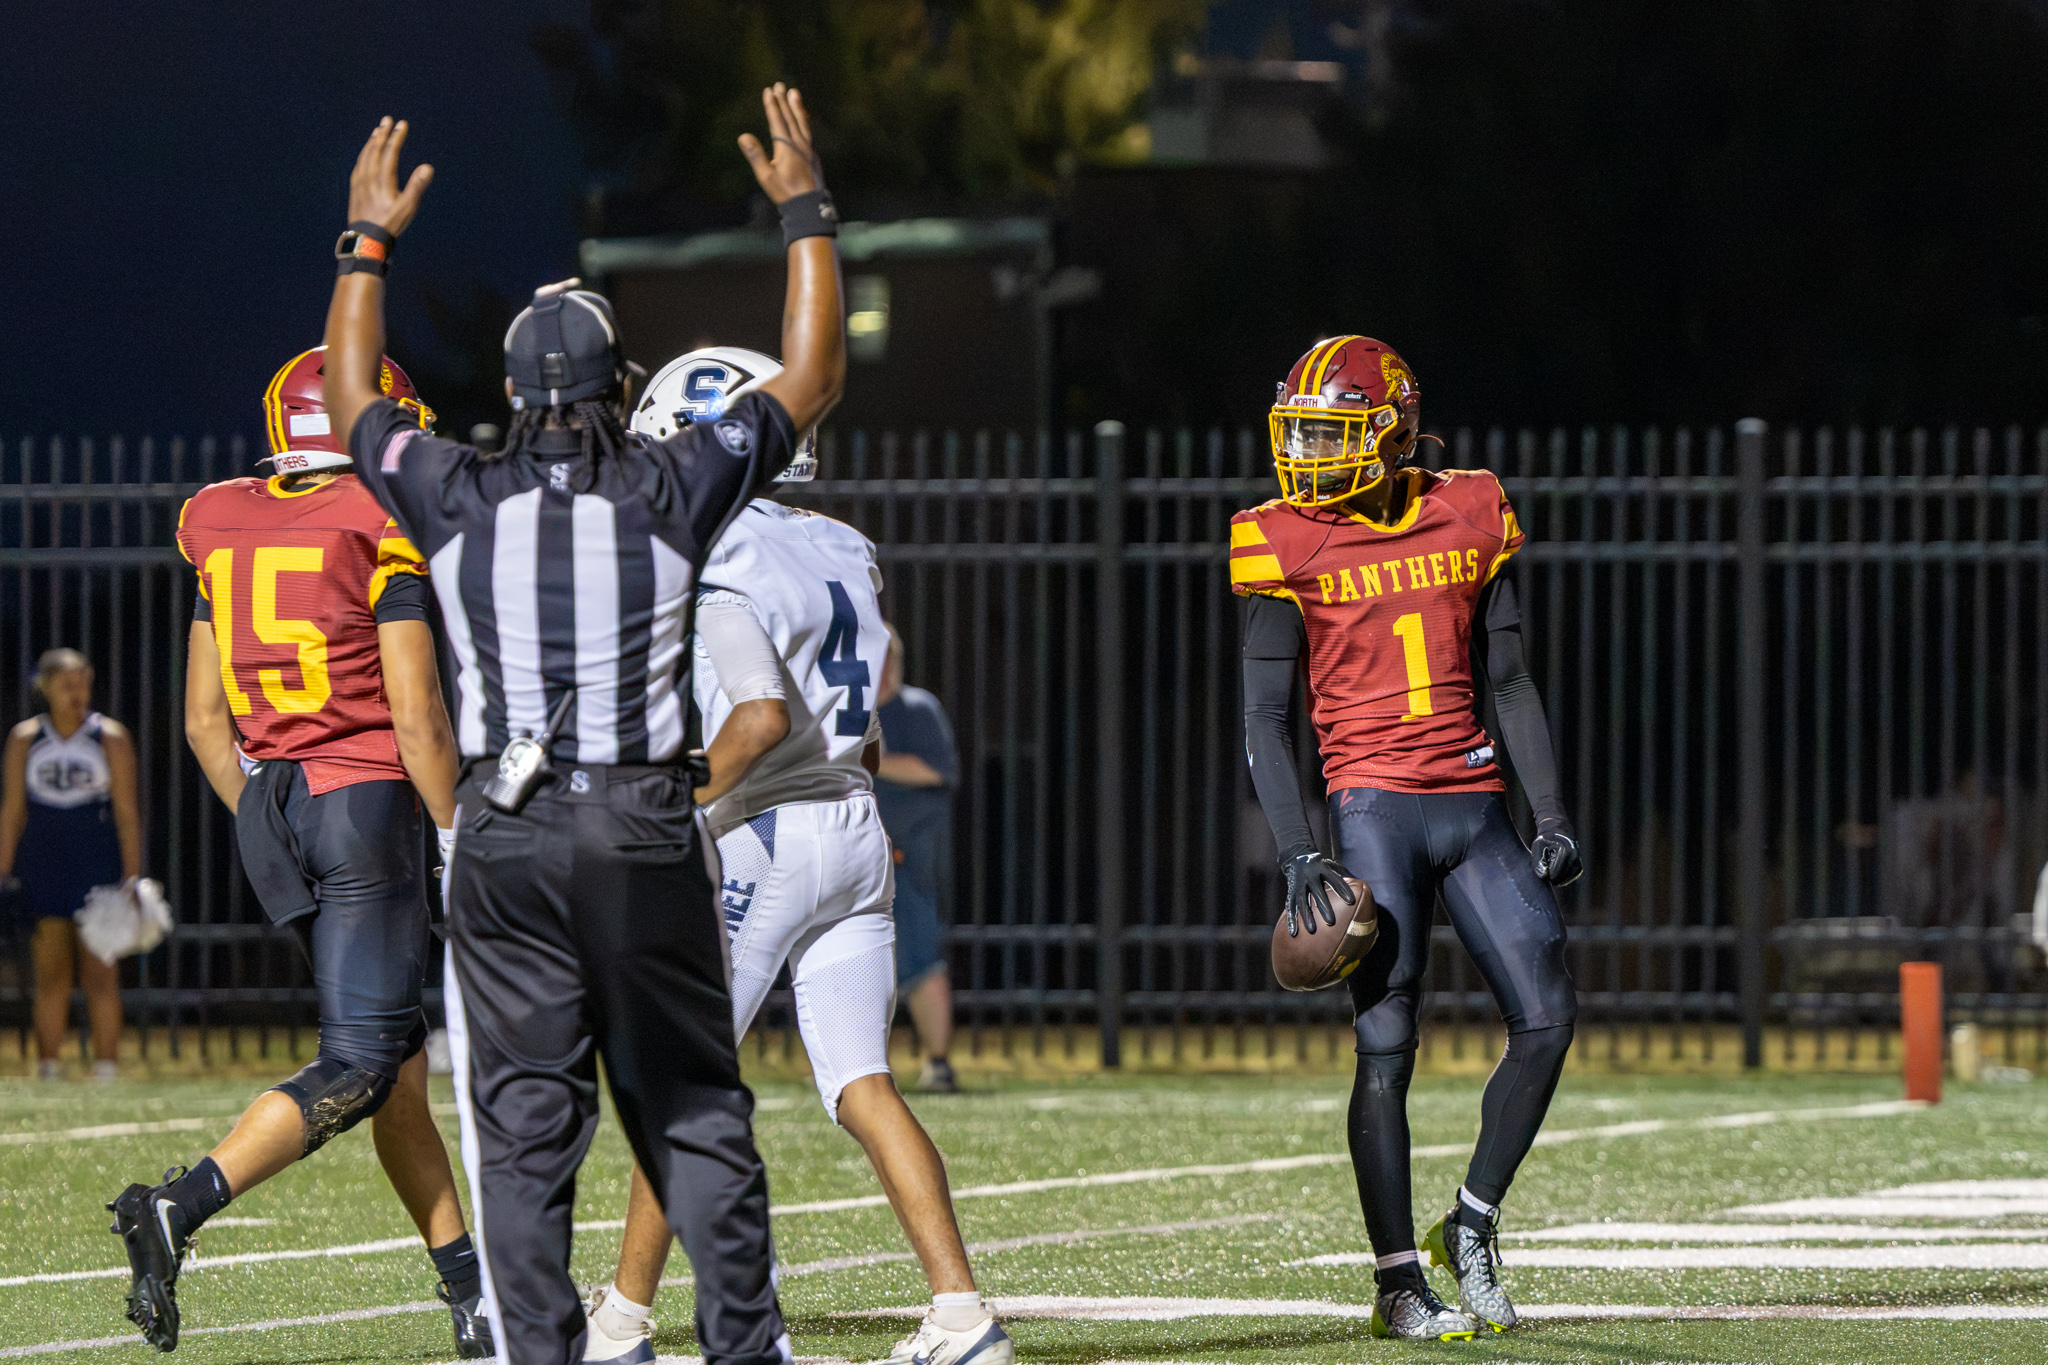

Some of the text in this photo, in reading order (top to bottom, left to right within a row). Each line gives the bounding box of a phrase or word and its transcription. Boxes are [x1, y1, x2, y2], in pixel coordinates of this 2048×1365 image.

[681, 366, 729, 424] S
[1294, 397, 1318, 408] NORTH
[1316, 548, 1479, 605] PANTHERS
[204, 546, 333, 716] 15
[817, 580, 871, 737] 4
[1392, 612, 1433, 722] 1
[570, 770, 591, 794] S
[723, 879, 757, 933] NEE
